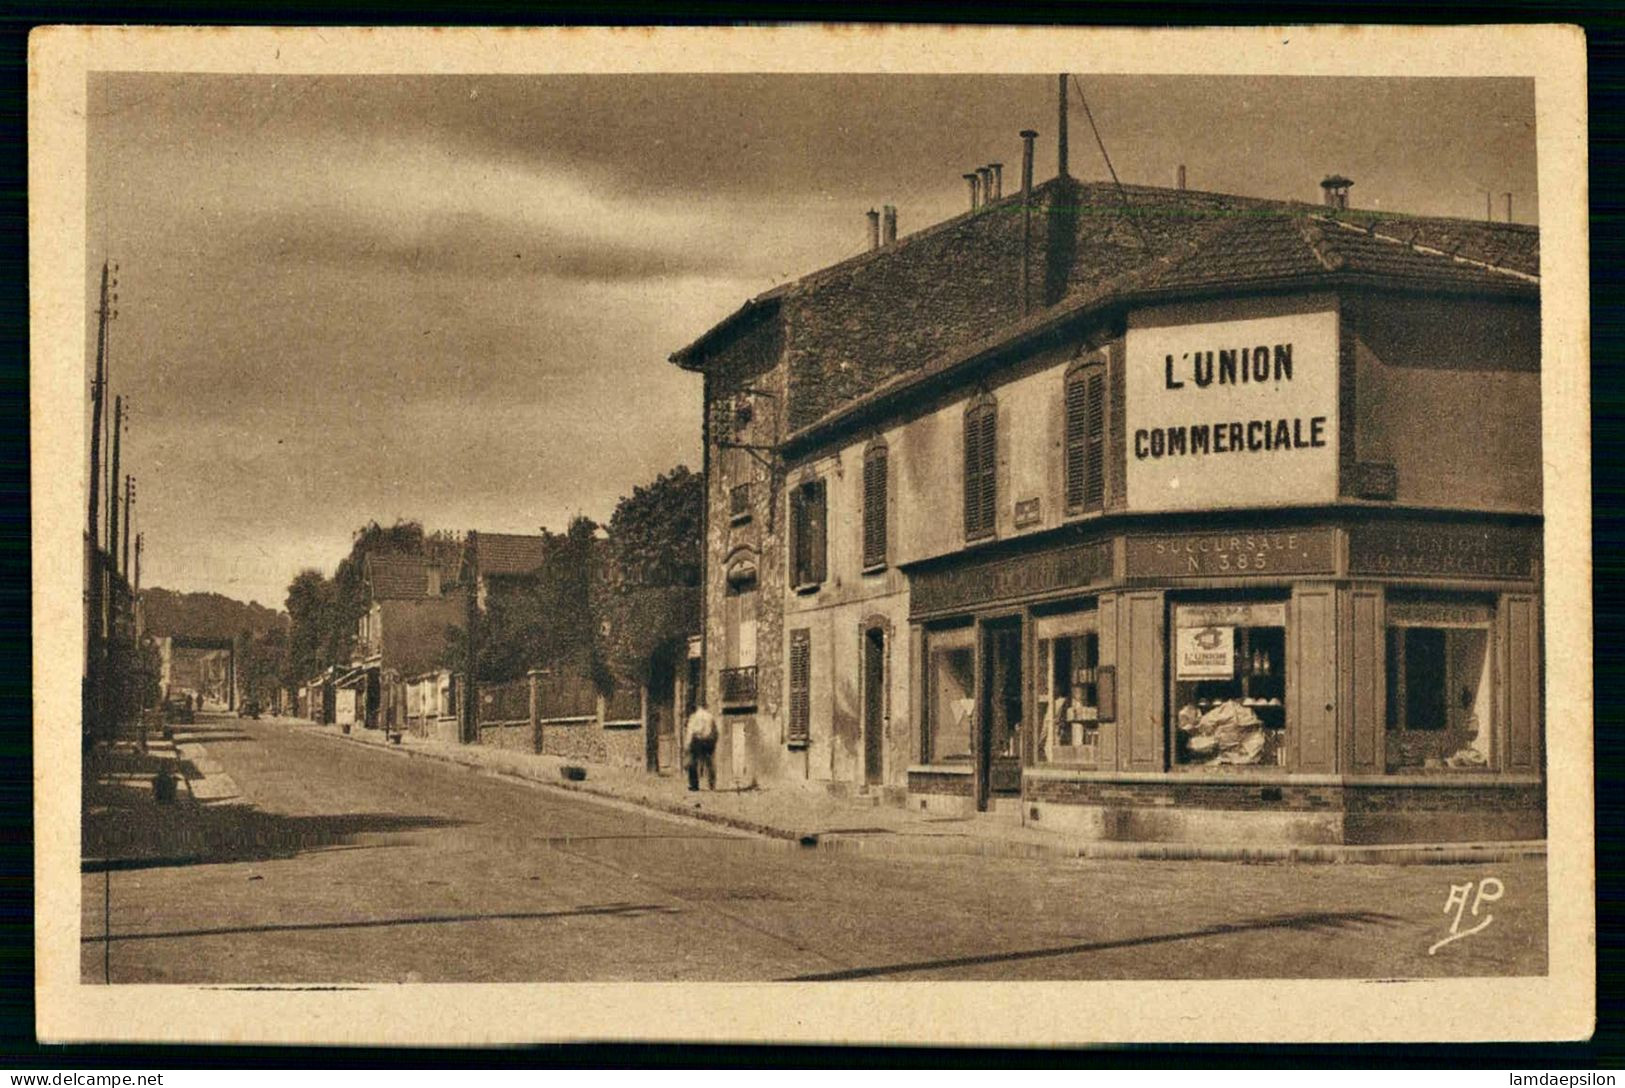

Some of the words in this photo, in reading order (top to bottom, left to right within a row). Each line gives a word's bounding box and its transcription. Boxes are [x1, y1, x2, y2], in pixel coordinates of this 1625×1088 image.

[1165, 343, 1293, 390] L'UNION
[1134, 416, 1327, 460] COMMERCIALE
[1155, 534, 1298, 554] SUCCURSALE
[1394, 534, 1488, 552] LUNION
[1219, 552, 1267, 570] 385
